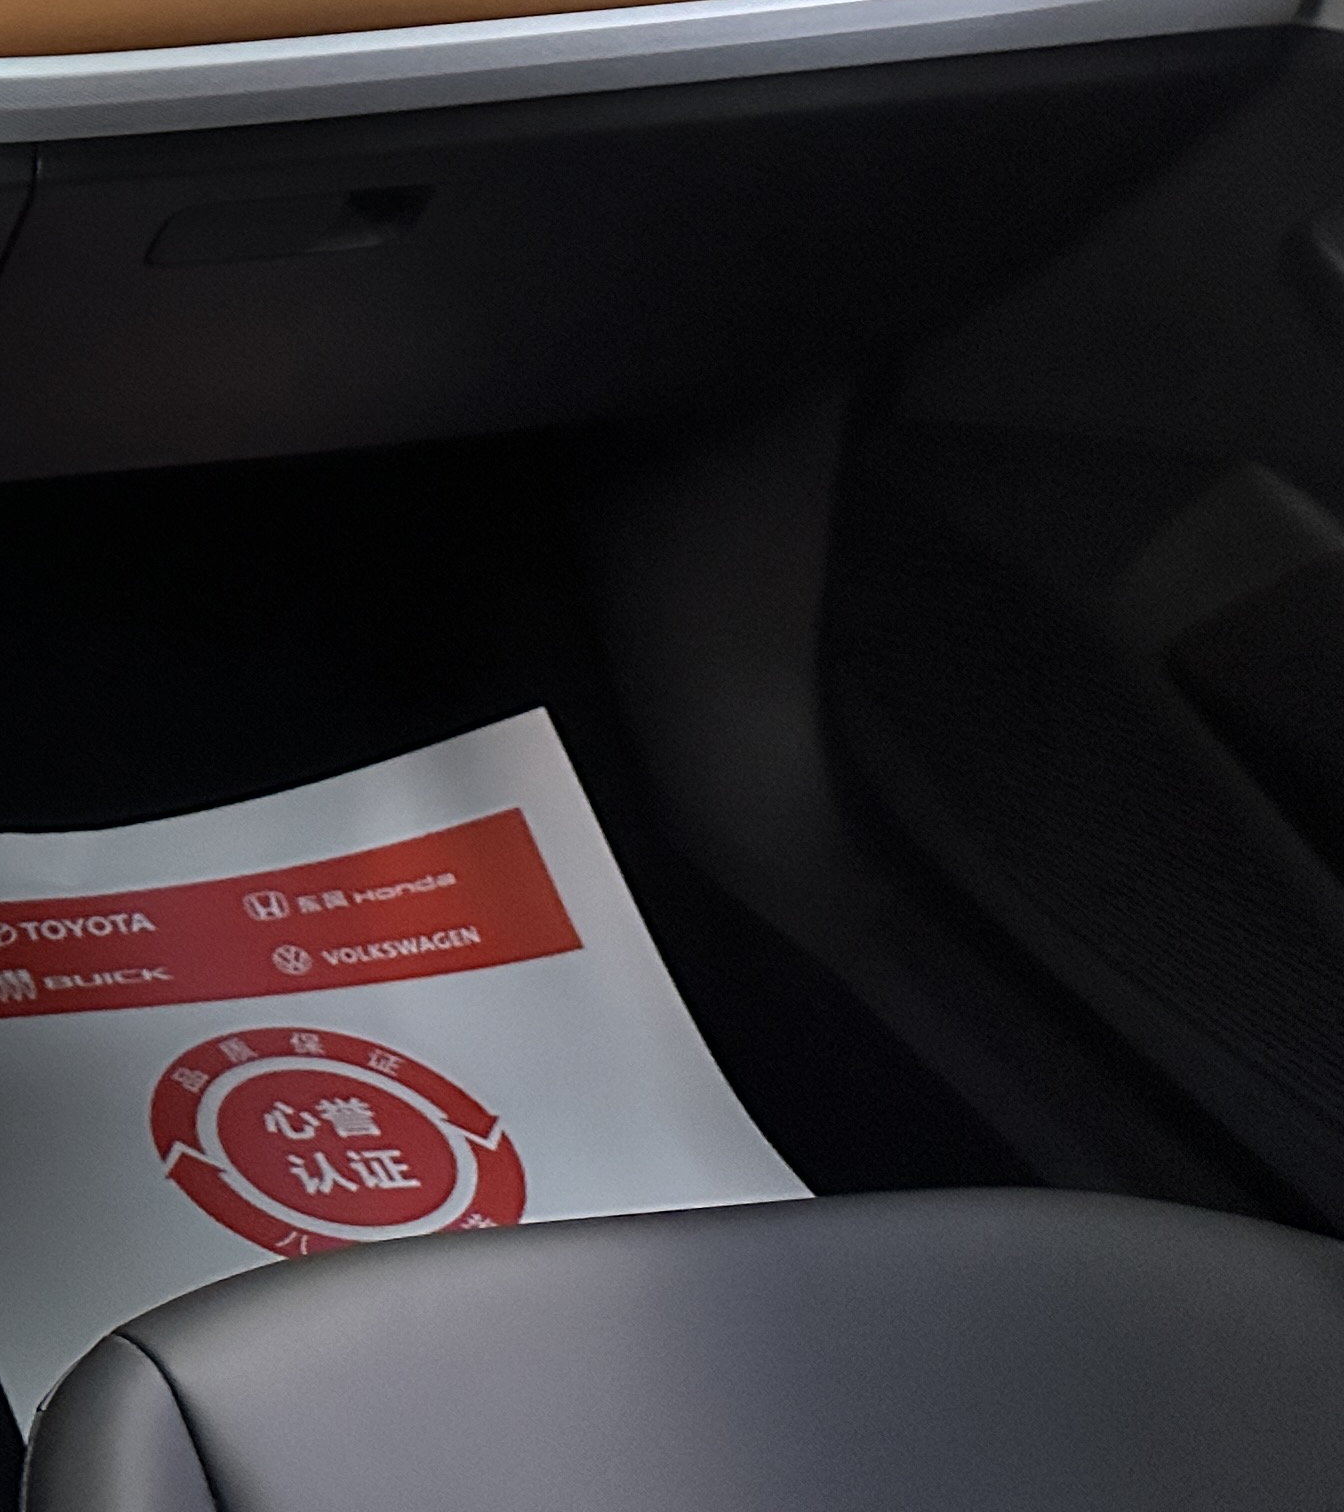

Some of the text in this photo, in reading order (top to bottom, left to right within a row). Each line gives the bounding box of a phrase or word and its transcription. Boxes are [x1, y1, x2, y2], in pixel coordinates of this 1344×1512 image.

[19, 912, 157, 942] TOYOTA
[320, 926, 482, 967] VOLKSWAGEN
[42, 966, 175, 991] BUICK
[262, 1096, 383, 1141] 心誉
[285, 1148, 422, 1196] 认证
